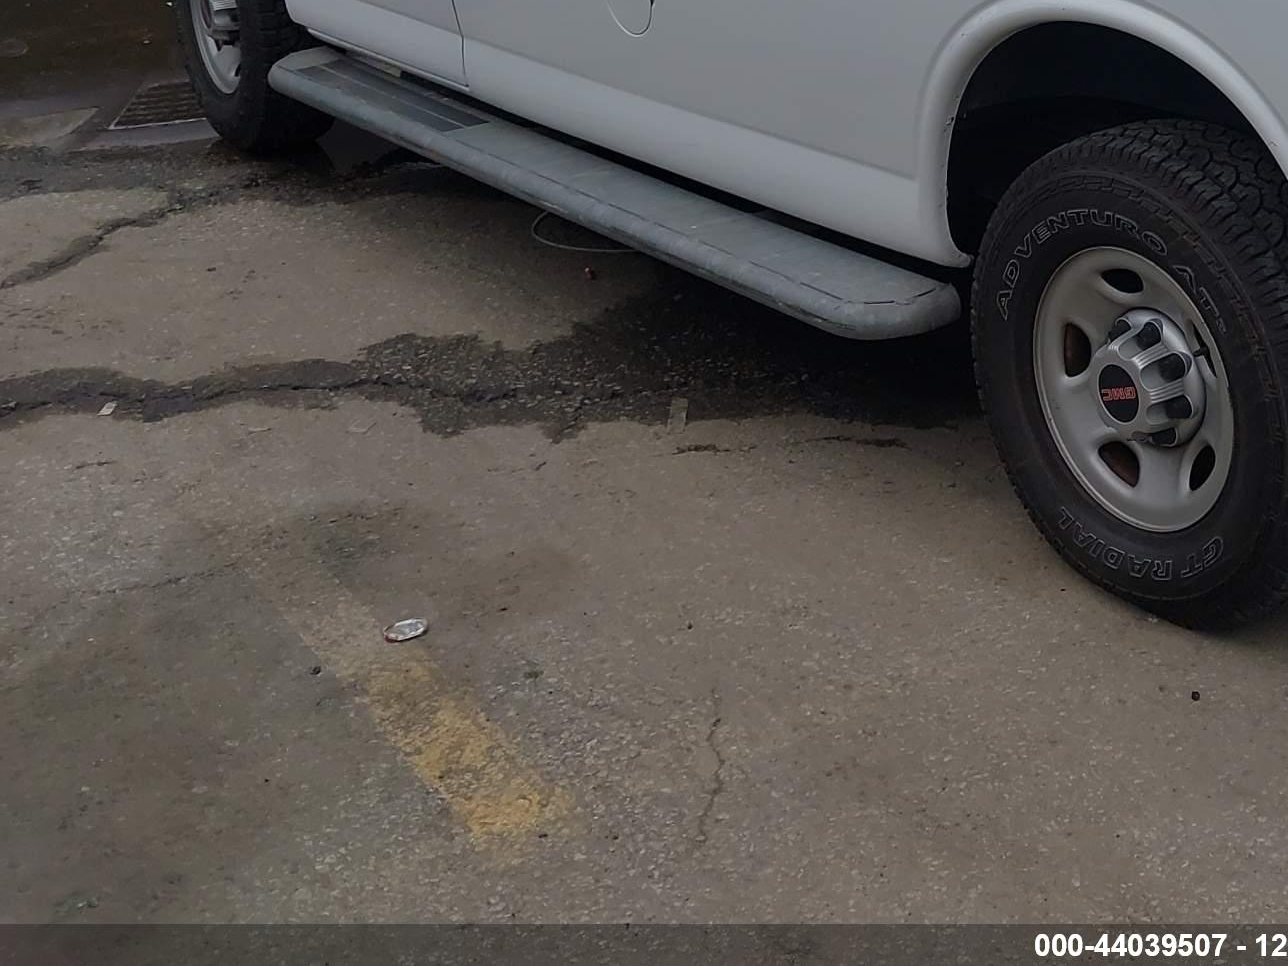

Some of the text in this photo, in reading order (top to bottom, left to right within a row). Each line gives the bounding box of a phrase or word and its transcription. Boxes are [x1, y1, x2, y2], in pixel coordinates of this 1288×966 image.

[996, 209, 1168, 321] ADVENTURO
[1101, 387, 1136, 401] GMC
[1056, 506, 1224, 580] GT RADIAL
